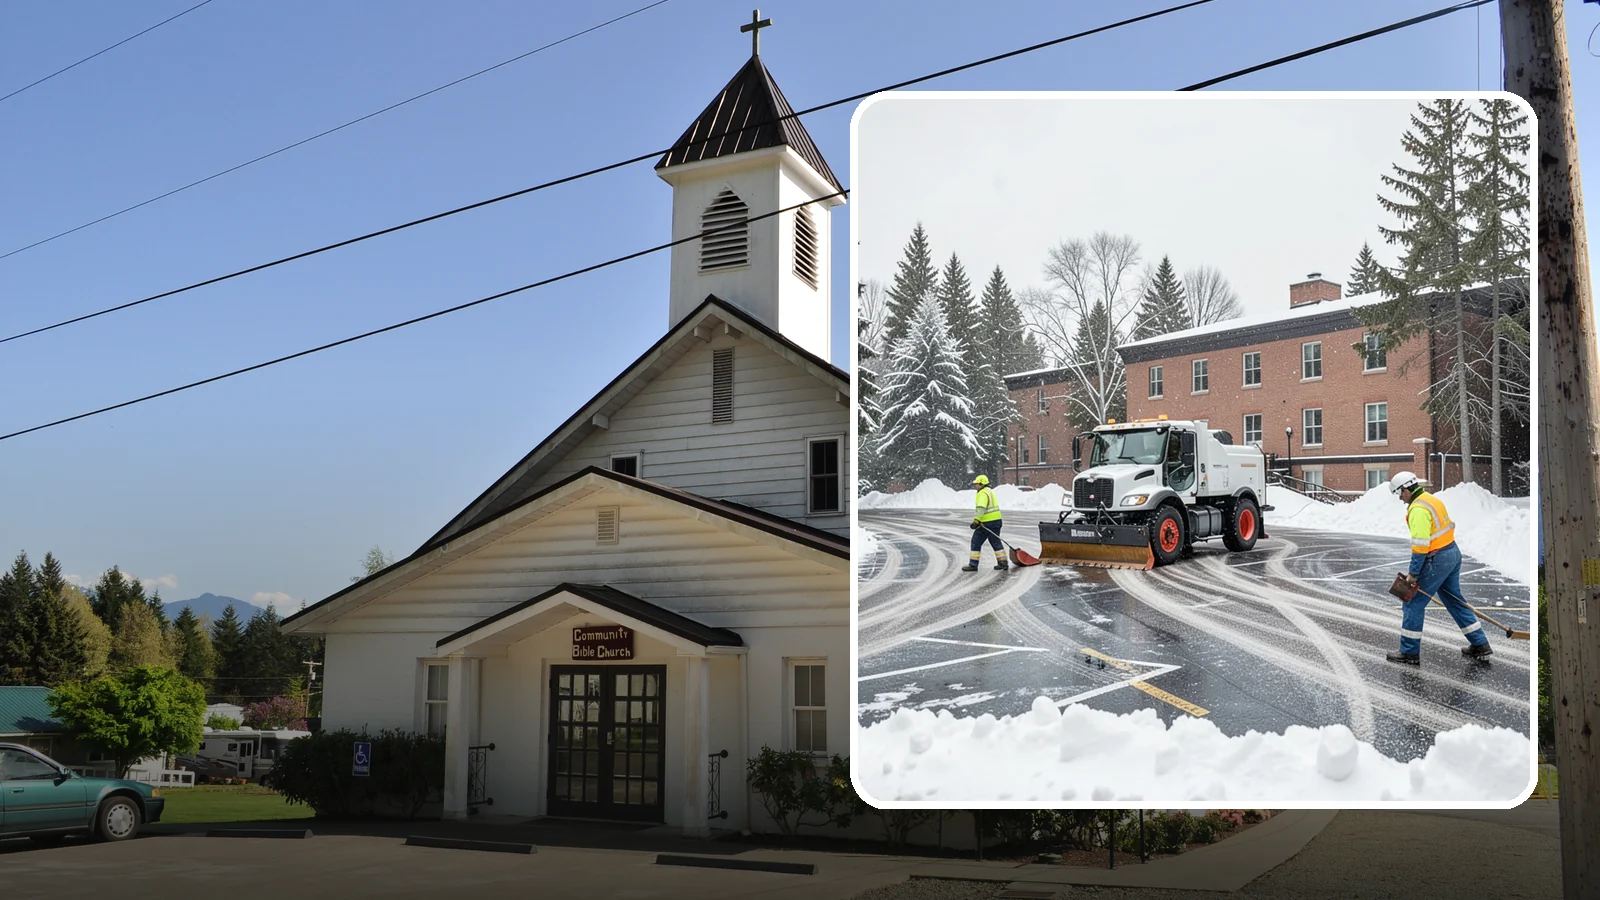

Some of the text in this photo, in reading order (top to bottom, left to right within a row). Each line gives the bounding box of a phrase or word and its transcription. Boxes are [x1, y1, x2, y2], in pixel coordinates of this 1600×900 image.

[574, 627, 628, 641] Community
[572, 644, 631, 658] Bible Church
